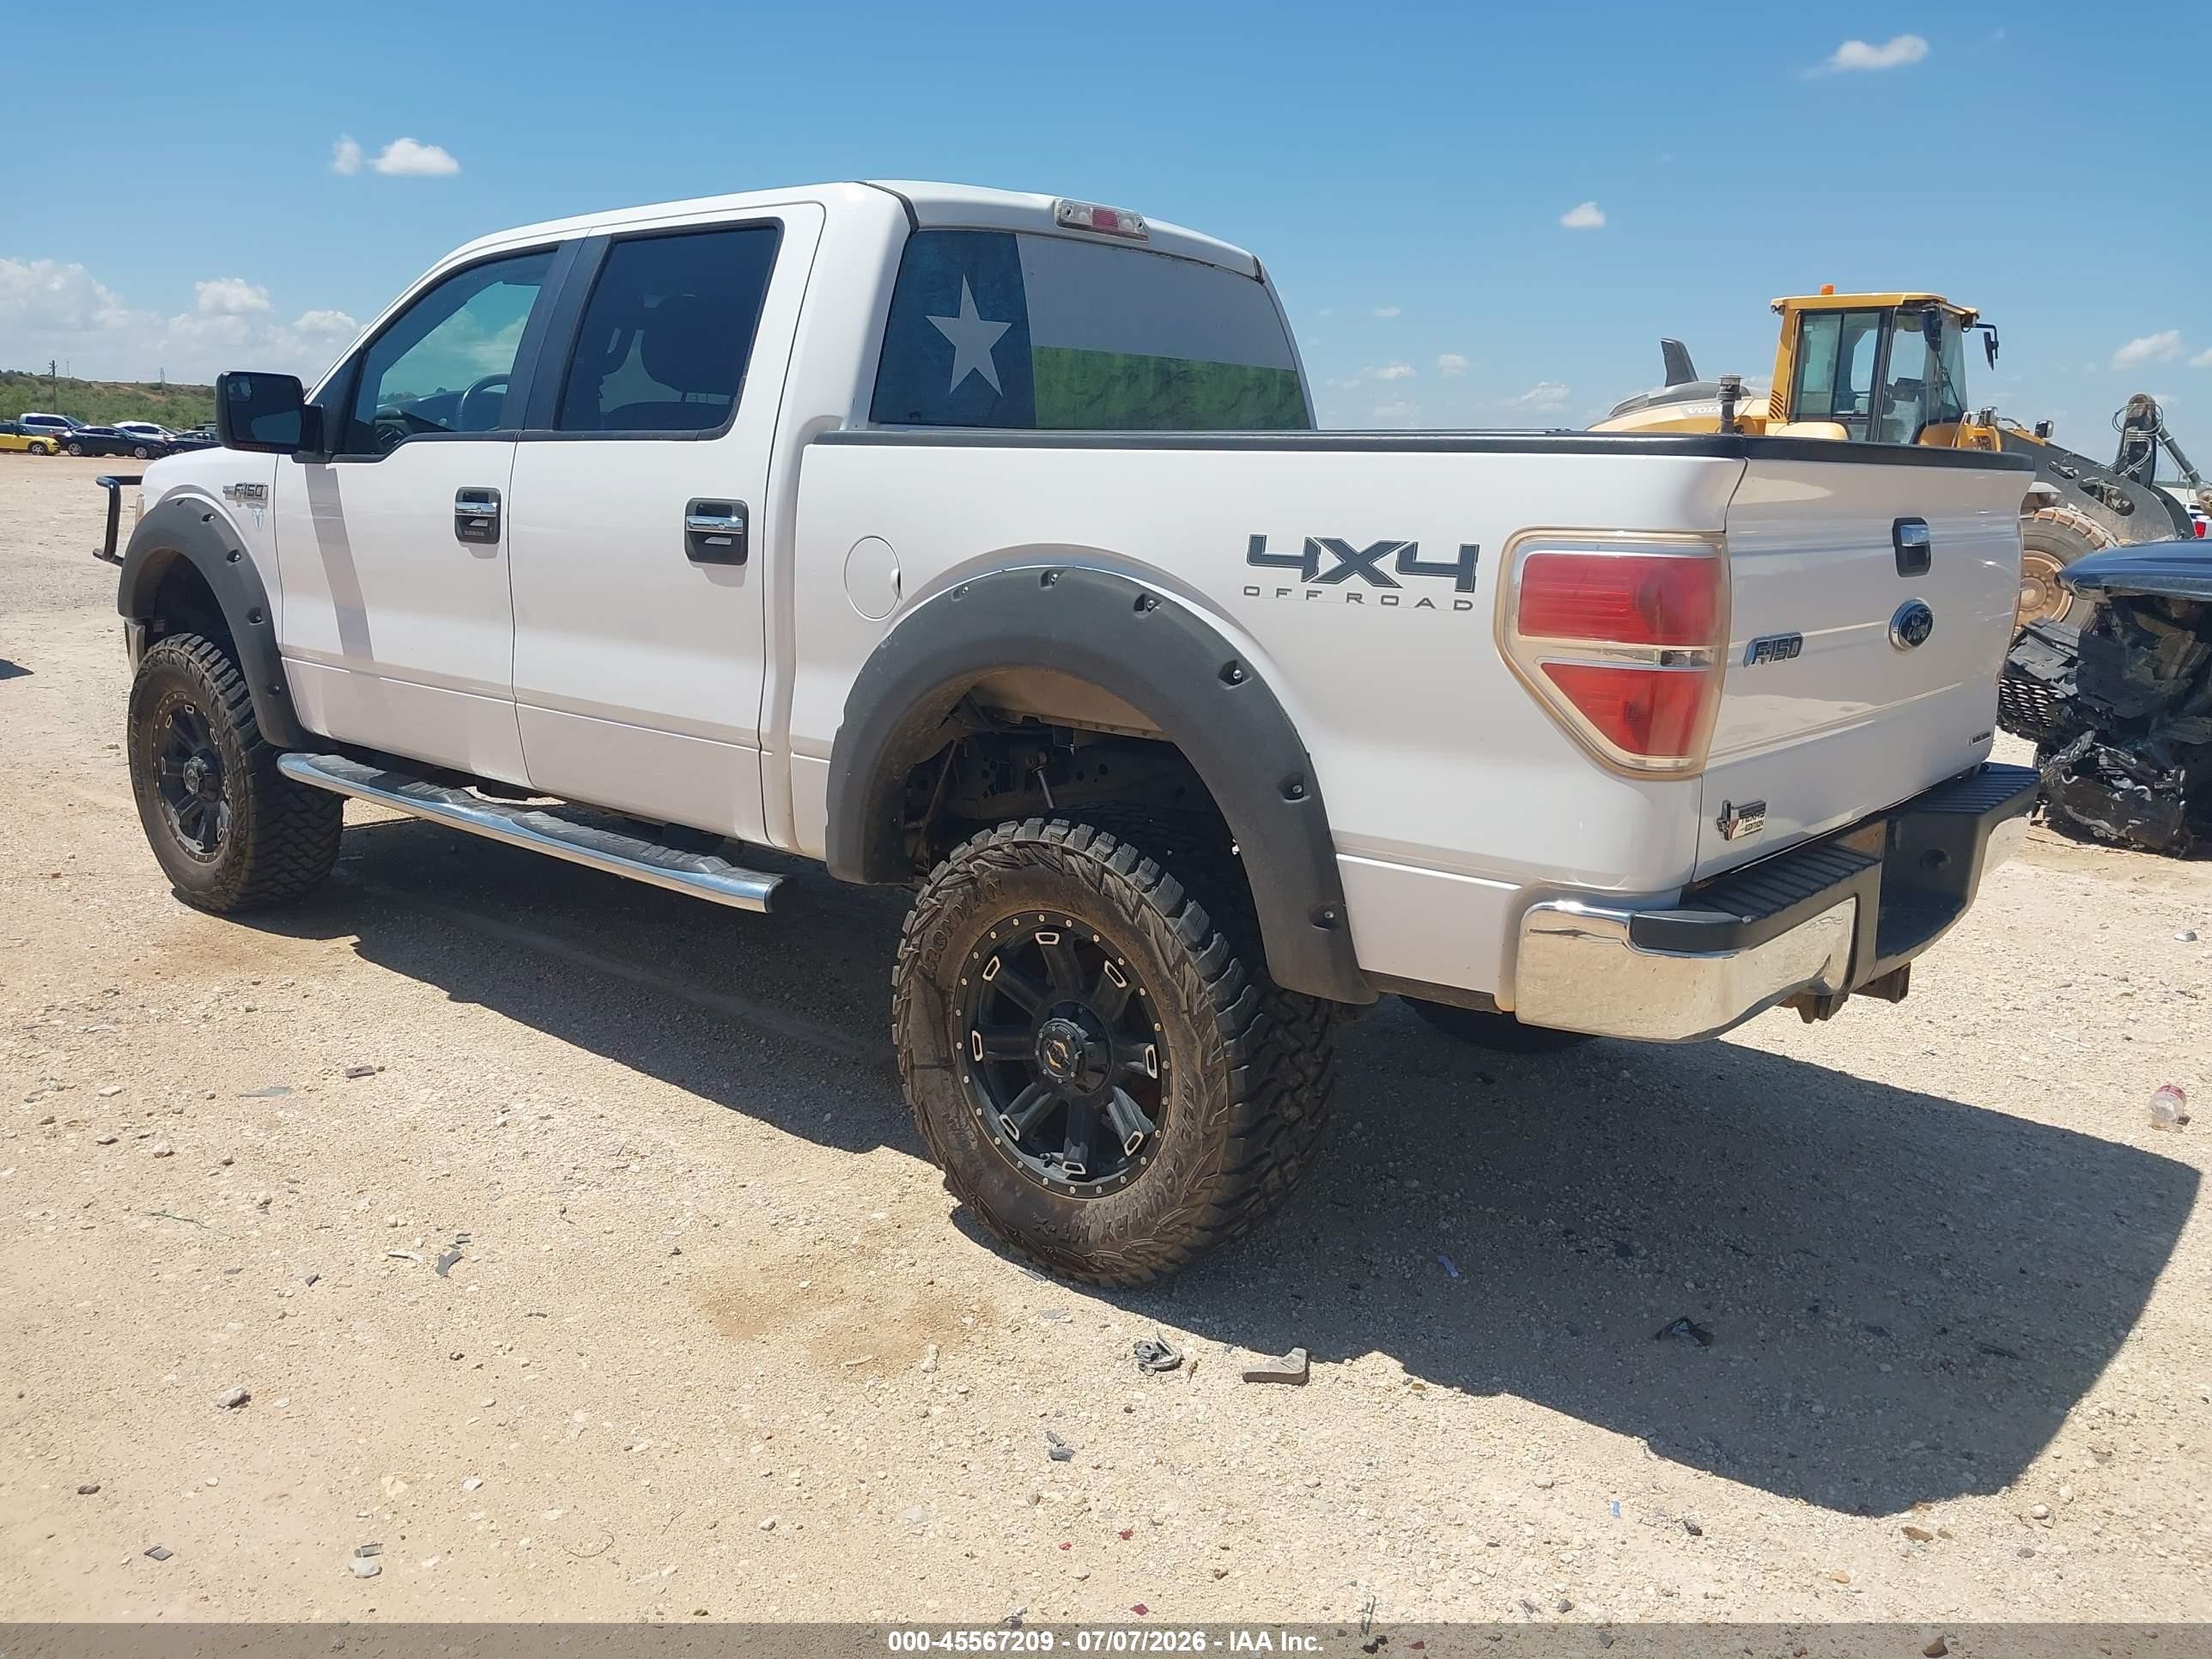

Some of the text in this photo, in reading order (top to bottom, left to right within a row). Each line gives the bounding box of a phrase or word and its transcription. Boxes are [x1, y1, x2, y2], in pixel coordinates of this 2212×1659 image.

[1905, 610, 1931, 641] Ford
[1748, 635, 1802, 665] F-150
[1739, 810, 1765, 824] TEXAS
[1744, 819, 1765, 832] EDITION
